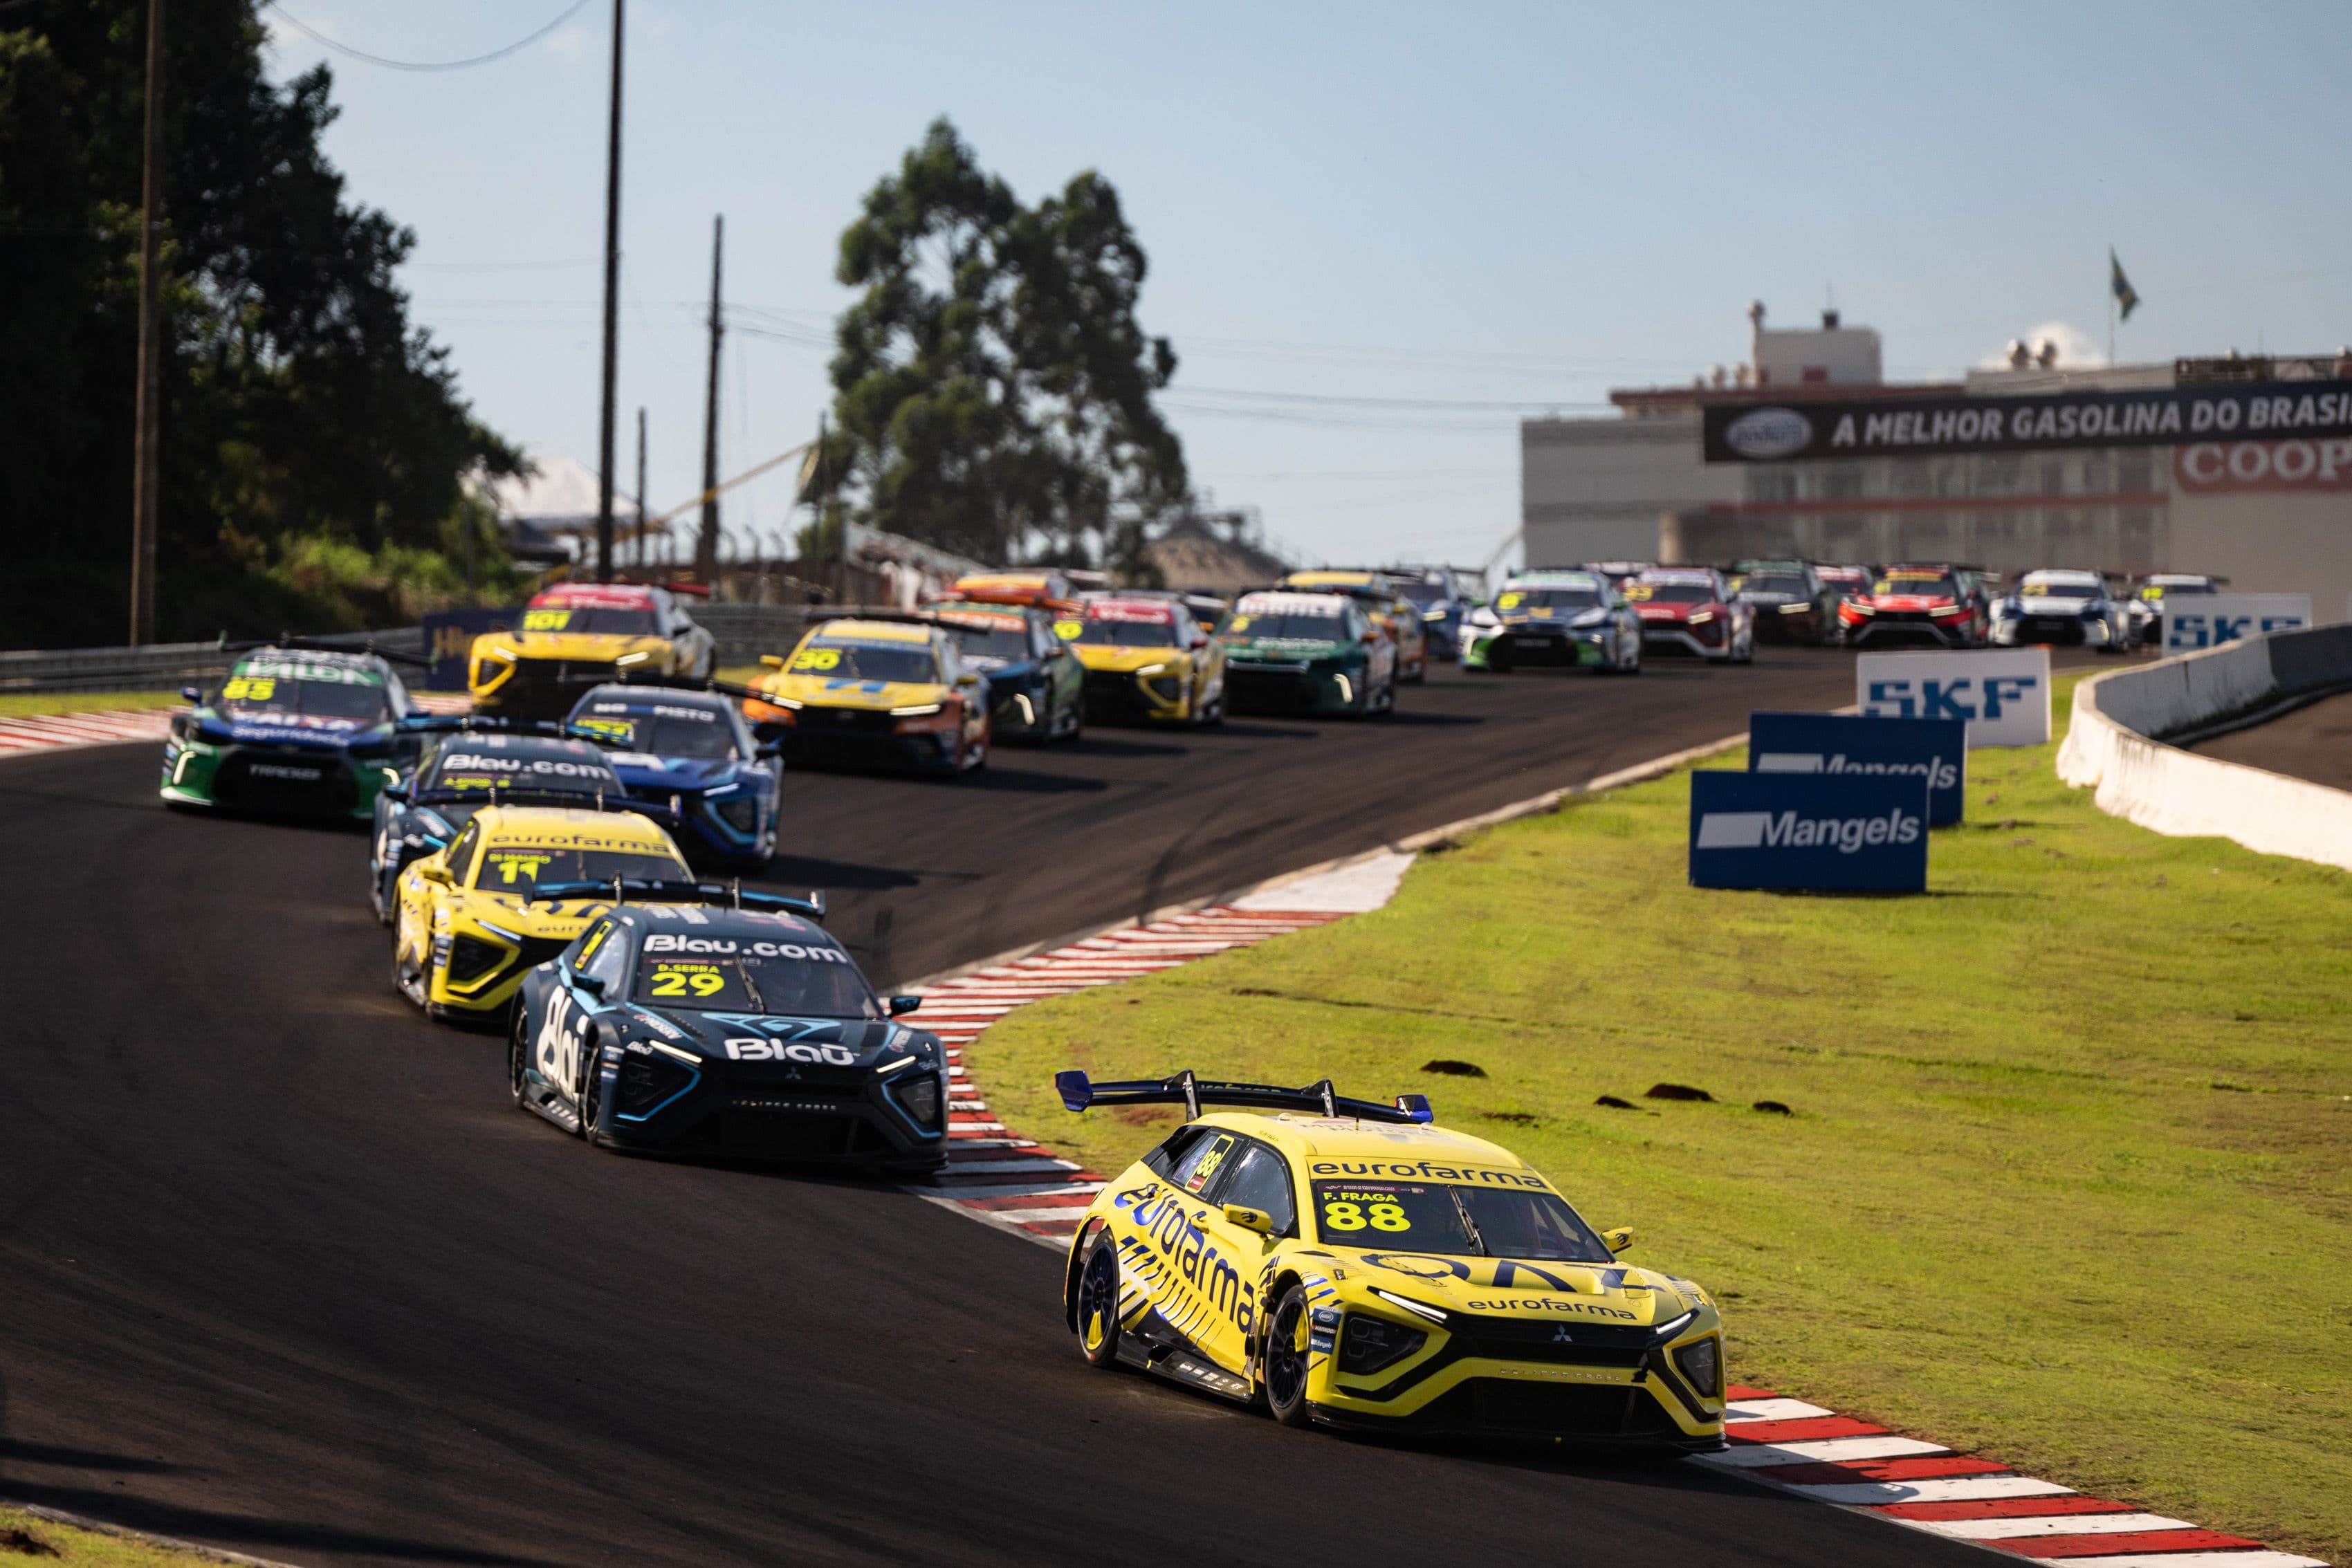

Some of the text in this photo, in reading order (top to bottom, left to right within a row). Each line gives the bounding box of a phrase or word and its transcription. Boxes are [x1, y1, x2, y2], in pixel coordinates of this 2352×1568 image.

[1830, 415, 1857, 448] A
[1864, 408, 2003, 444] MELHOR
[2012, 401, 2180, 441] GASOLINA
[2192, 398, 2240, 432] DO
[2248, 392, 2352, 429] BRASI
[1866, 676, 2037, 719] SKF
[493, 834, 669, 852] eurofarma
[1764, 808, 1920, 854] Mangels
[651, 972, 725, 996] 29
[1312, 1162, 1549, 1189] eurofarma
[1341, 1192, 1399, 1202] FRAGA
[1325, 1201, 1412, 1232] 88
[1114, 1183, 1255, 1334] eurofarma
[1467, 1298, 1638, 1320] eurofarma
